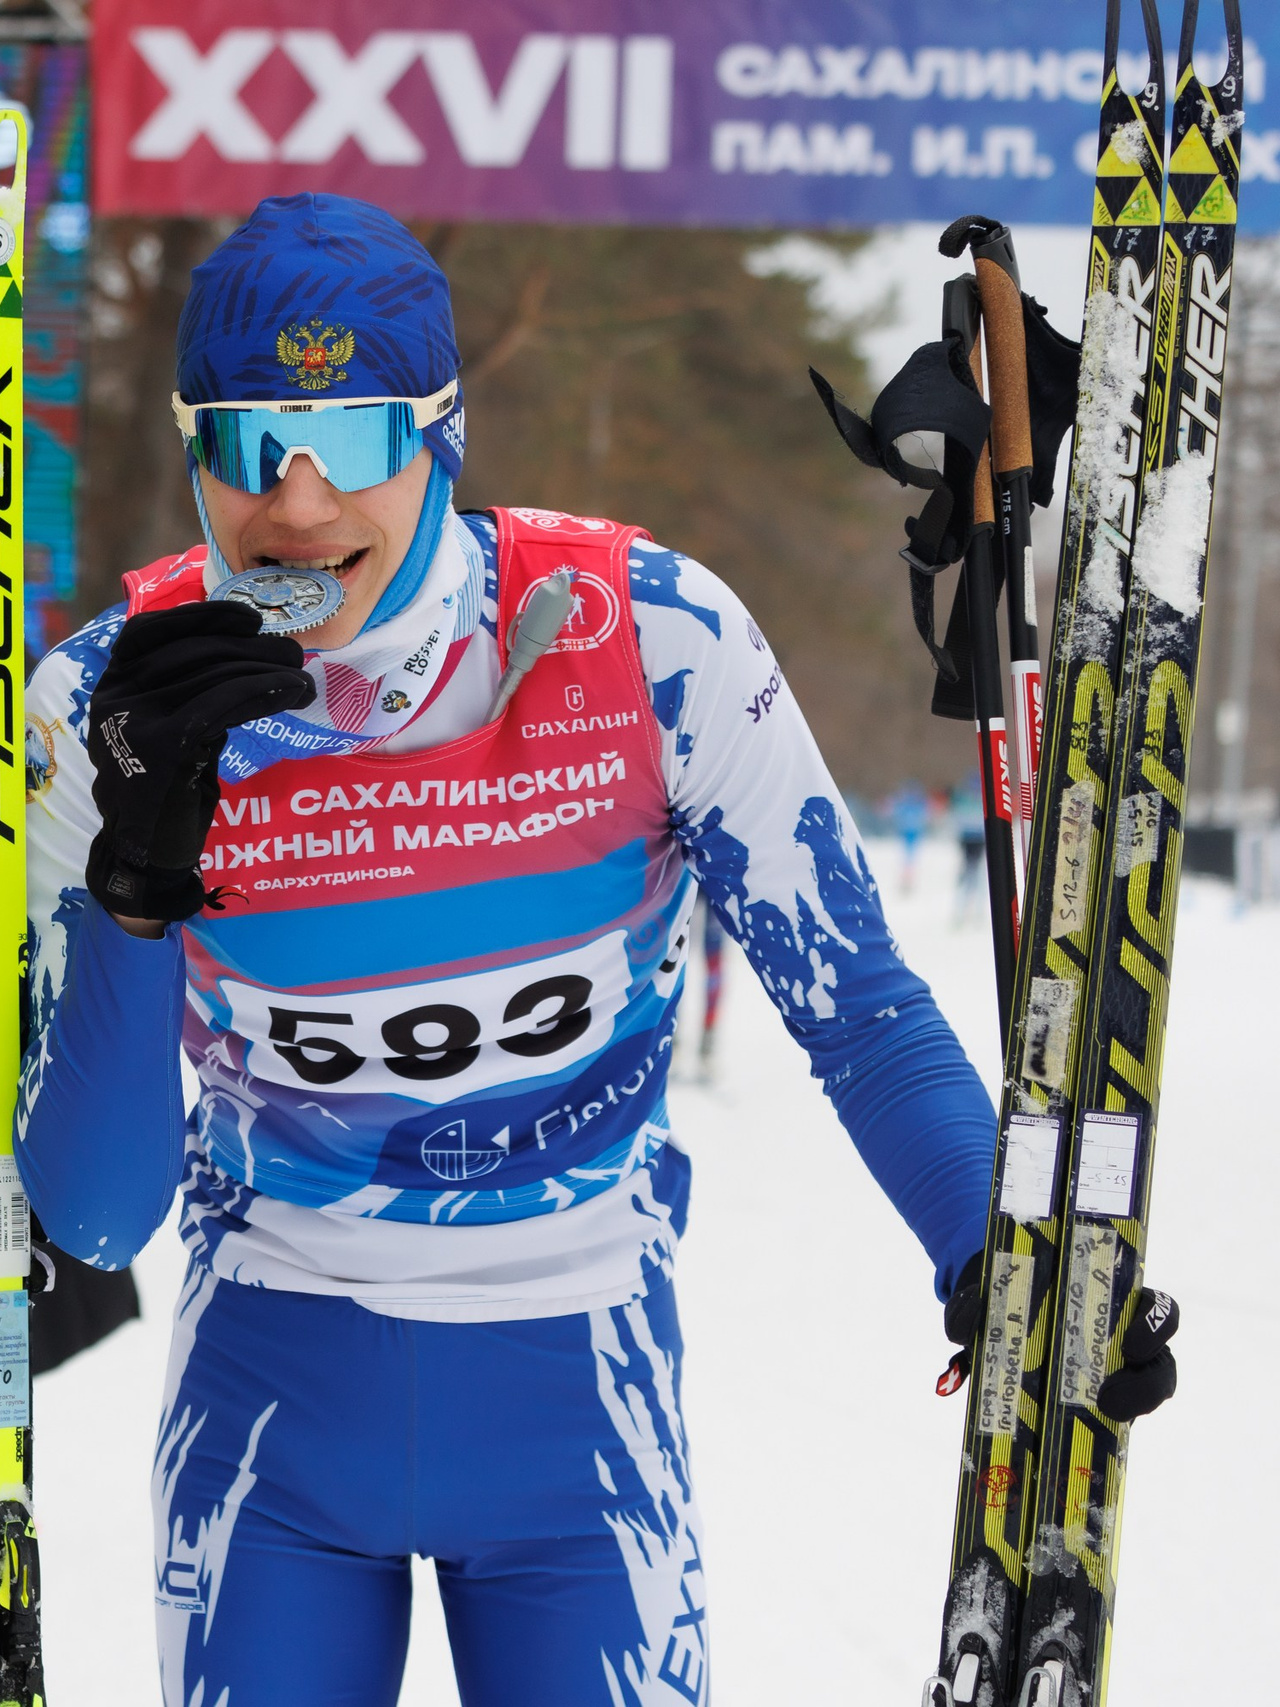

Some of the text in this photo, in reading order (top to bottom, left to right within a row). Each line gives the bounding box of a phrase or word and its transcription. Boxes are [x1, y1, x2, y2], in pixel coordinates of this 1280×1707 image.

[129, 31, 673, 172] XXVII
[712, 123, 892, 175] ПАМ.
[913, 127, 1054, 179] И.П.
[1002, 489, 1012, 516] 175
[521, 711, 639, 739] САХАЛИН
[211, 751, 627, 827] VII САХАЛИНСКИЙ
[199, 798, 616, 872] ЫЖНЫЙ МАРАФОН
[253, 865, 415, 892] ФАРХУТДИНОВА
[267, 974, 593, 1086] 593
